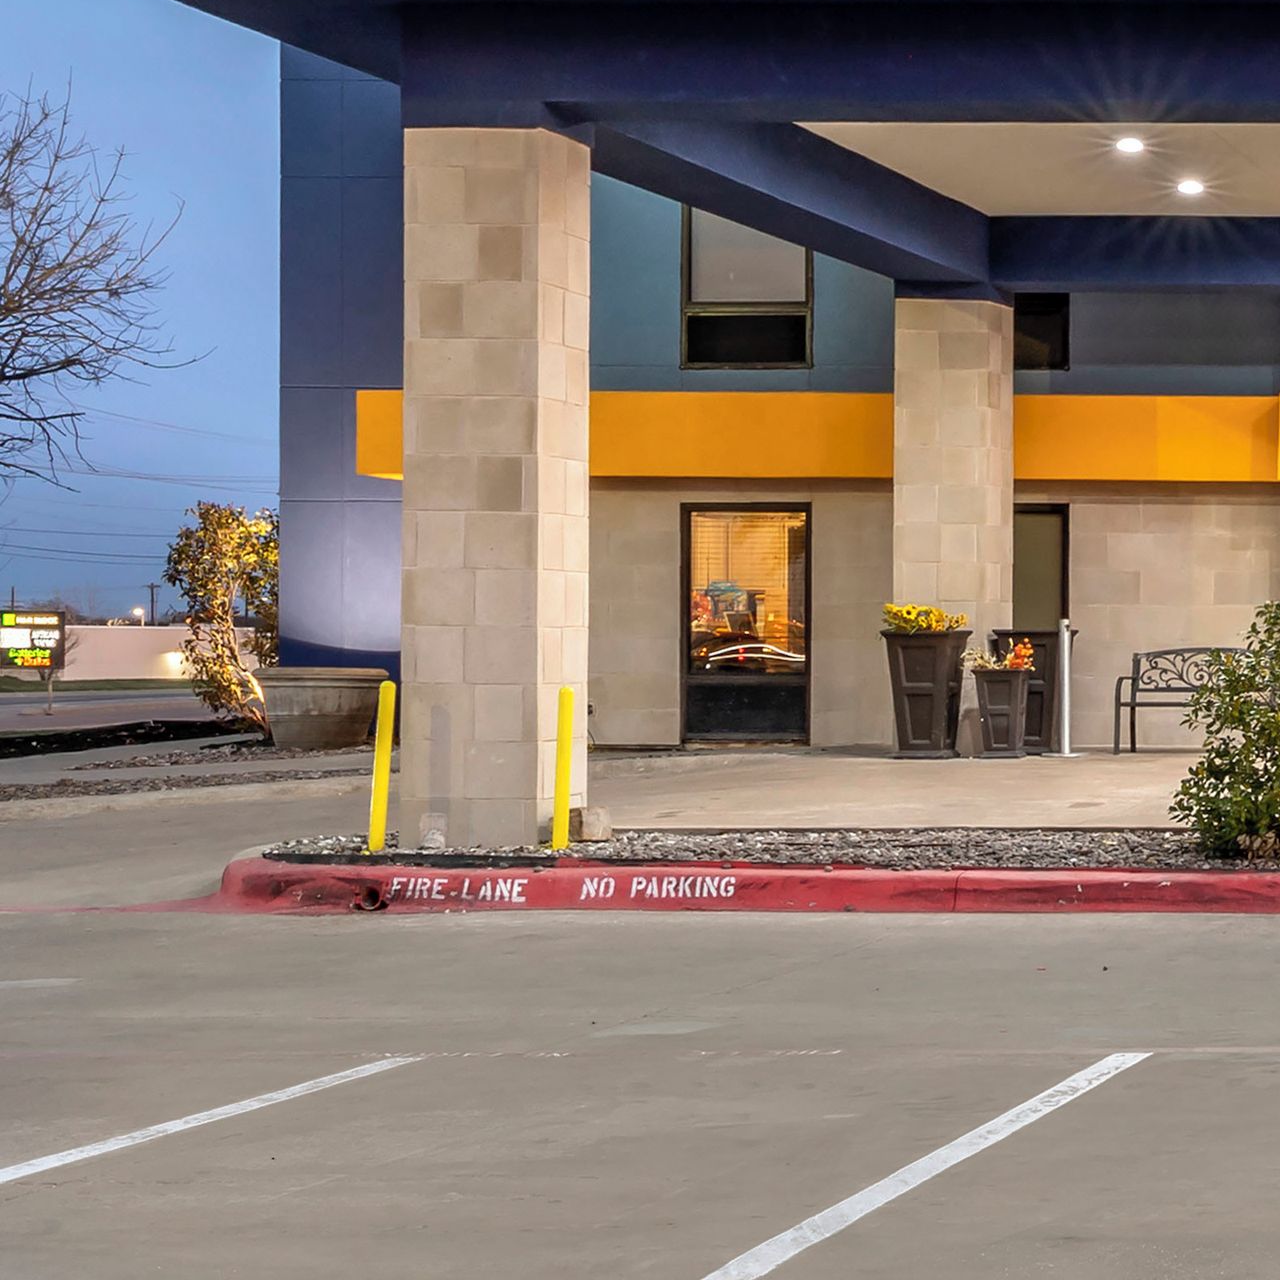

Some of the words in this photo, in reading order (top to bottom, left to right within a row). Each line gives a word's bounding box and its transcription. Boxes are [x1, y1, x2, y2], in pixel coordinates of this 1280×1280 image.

[387, 877, 448, 900] FIRE
[460, 877, 528, 903] LANE
[580, 876, 616, 900] NO
[630, 876, 736, 898] PARKING
